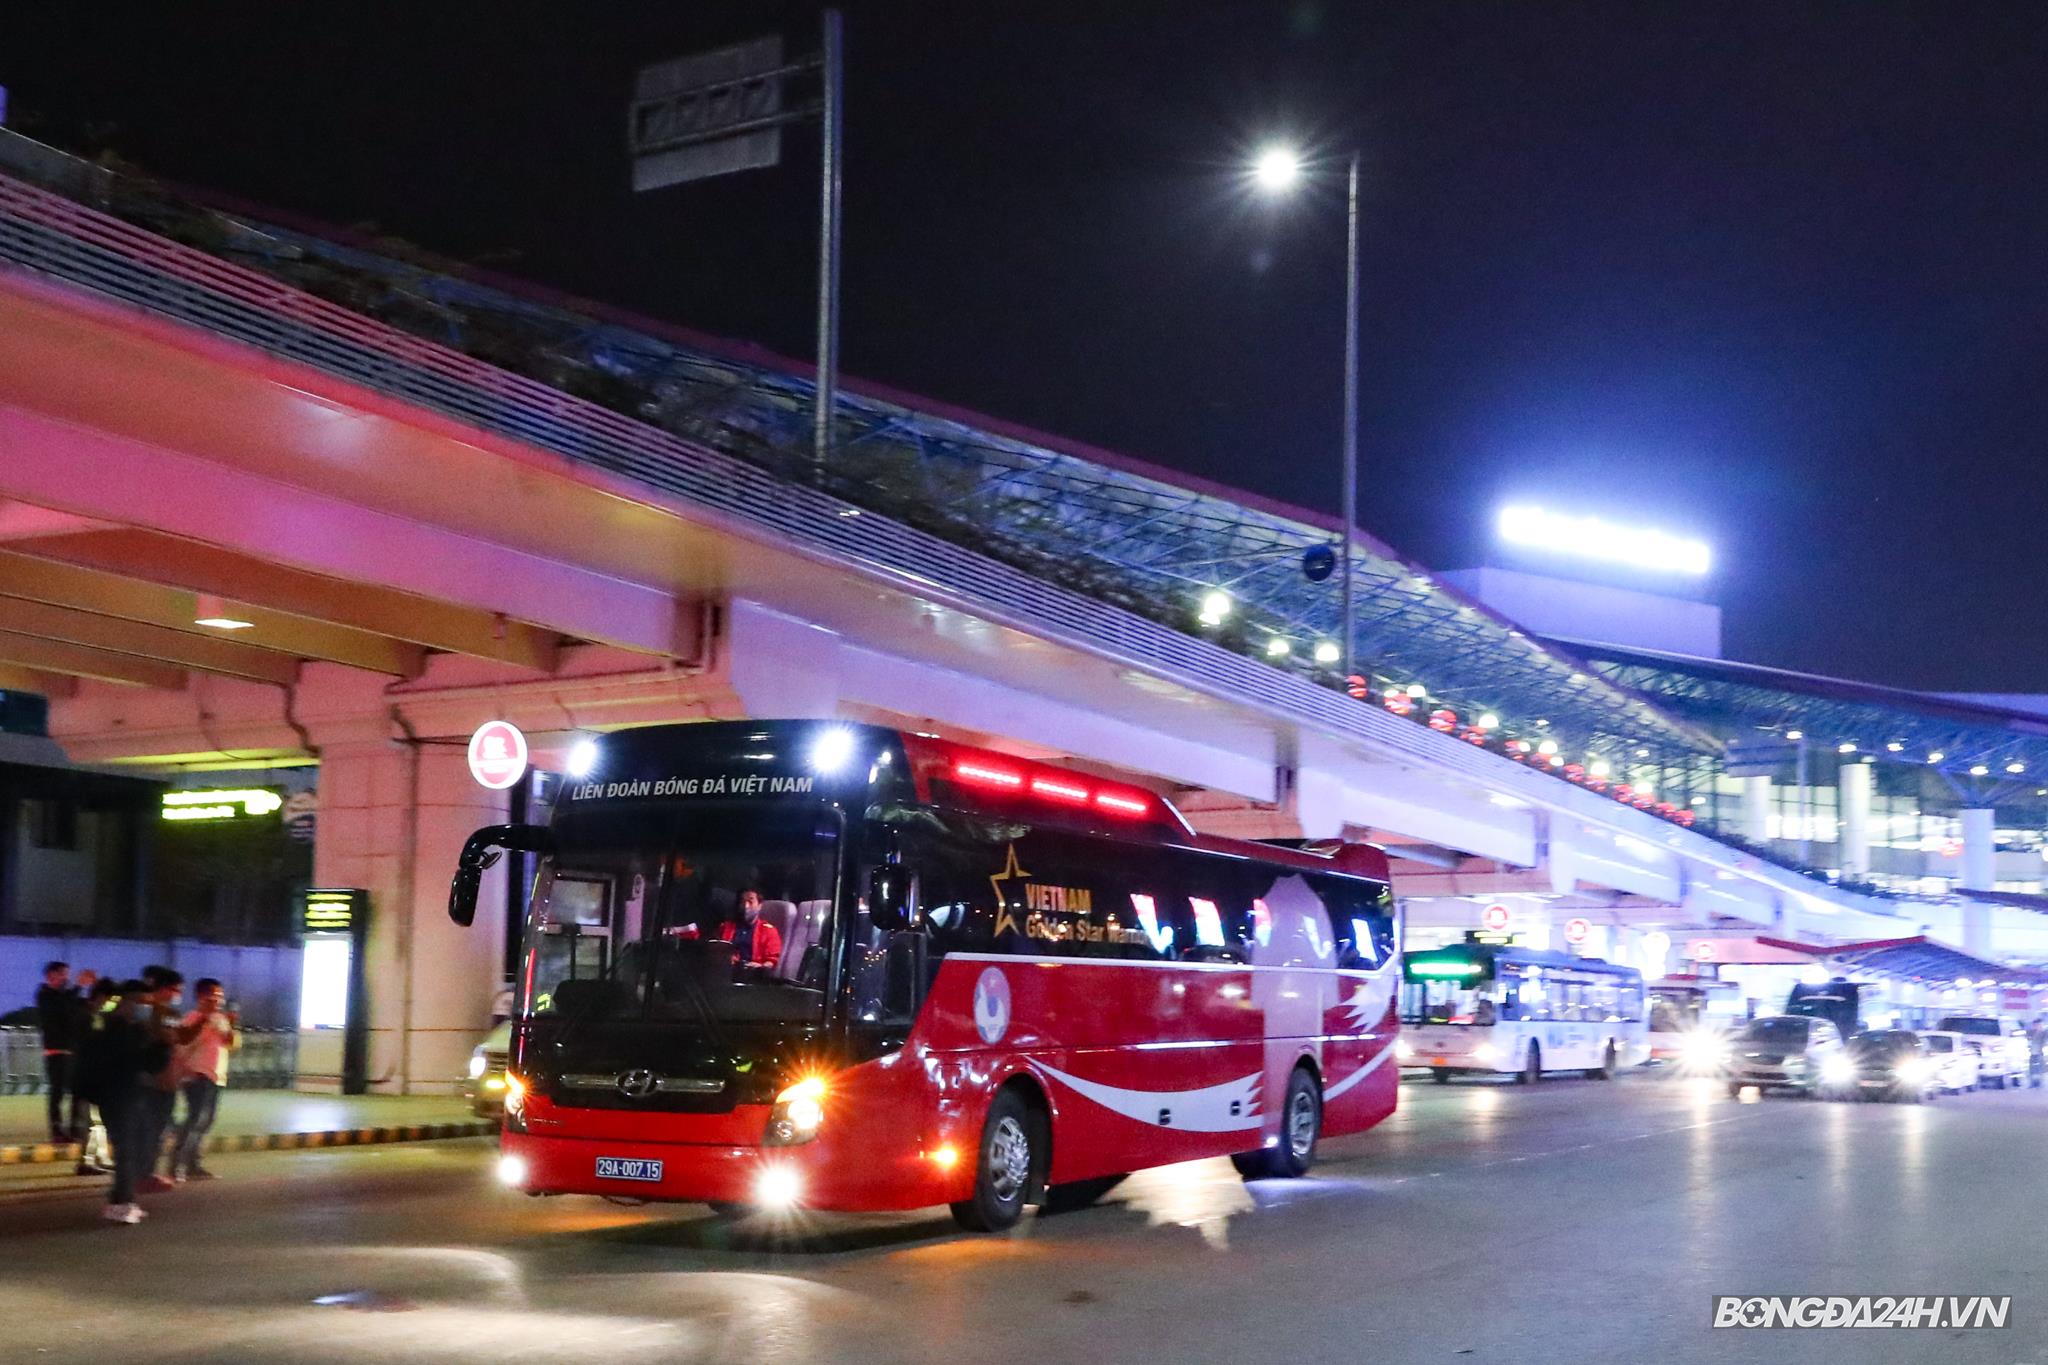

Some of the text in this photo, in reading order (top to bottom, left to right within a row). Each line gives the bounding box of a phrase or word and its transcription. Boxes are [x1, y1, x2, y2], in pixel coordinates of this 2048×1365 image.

[572, 774, 813, 800] LIÊN ĐOÀN BÓNG ĐÁ VIỆT NAM
[1025, 883, 1092, 914] VIETNAM
[1076, 918, 1106, 943] Star
[598, 1160, 660, 1178] 29A-007.15
